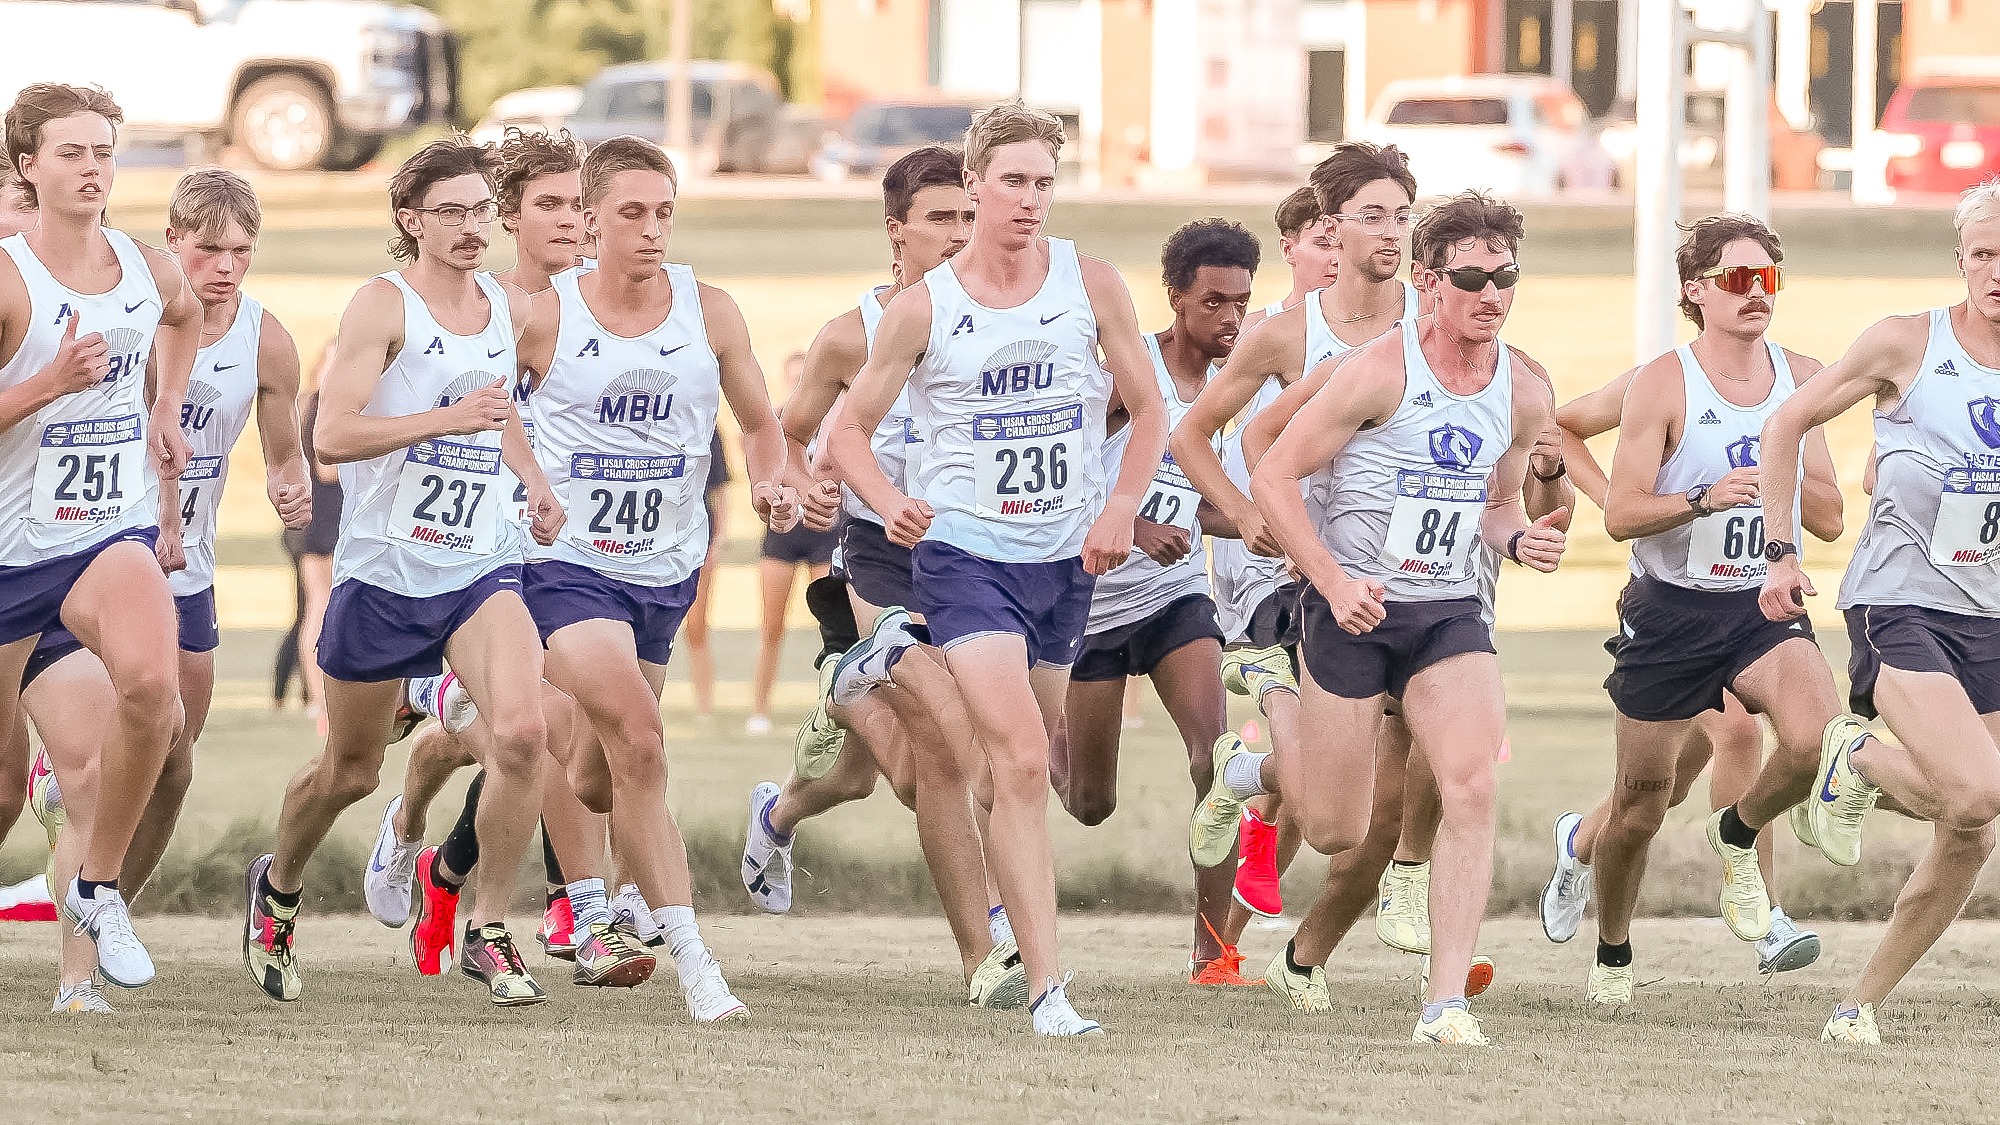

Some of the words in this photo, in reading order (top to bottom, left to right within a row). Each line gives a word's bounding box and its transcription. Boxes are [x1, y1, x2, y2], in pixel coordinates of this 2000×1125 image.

[102, 352, 140, 382] BU
[981, 363, 1055, 397] MBU
[180, 403, 214, 430] BU
[599, 394, 674, 424] MBU
[1001, 415, 1026, 428] LHSAA
[1026, 413, 1051, 426] CROSS
[1051, 406, 1079, 422] COUNTRY
[73, 429, 135, 444] CHAMPIONSHIPS
[94, 420, 117, 433] CROSS
[1005, 418, 1073, 438] CHAMPIONSHIPS
[438, 455, 496, 473] CHAMPIONSHIPS
[460, 447, 481, 460] CROSS
[600, 457, 624, 468] LHSAA
[624, 458, 650, 470] CROSS
[54, 453, 123, 502] 251
[603, 467, 674, 480] CHAMPIONSHIPS
[995, 442, 1069, 495] 236
[1426, 487, 1481, 501] CHAMPIONSHIPS
[1445, 478, 1466, 490] CROSS
[179, 486, 200, 526] 4
[412, 474, 487, 528] 237
[588, 488, 663, 535] 248
[1001, 494, 1064, 516] MileSplit
[55, 506, 121, 523] MileSplit
[410, 526, 474, 550] MileSplit
[1415, 508, 1462, 556] 84
[1723, 515, 1765, 560] 60
[593, 537, 655, 557] MileSplit
[1399, 558, 1453, 579] MileSplit
